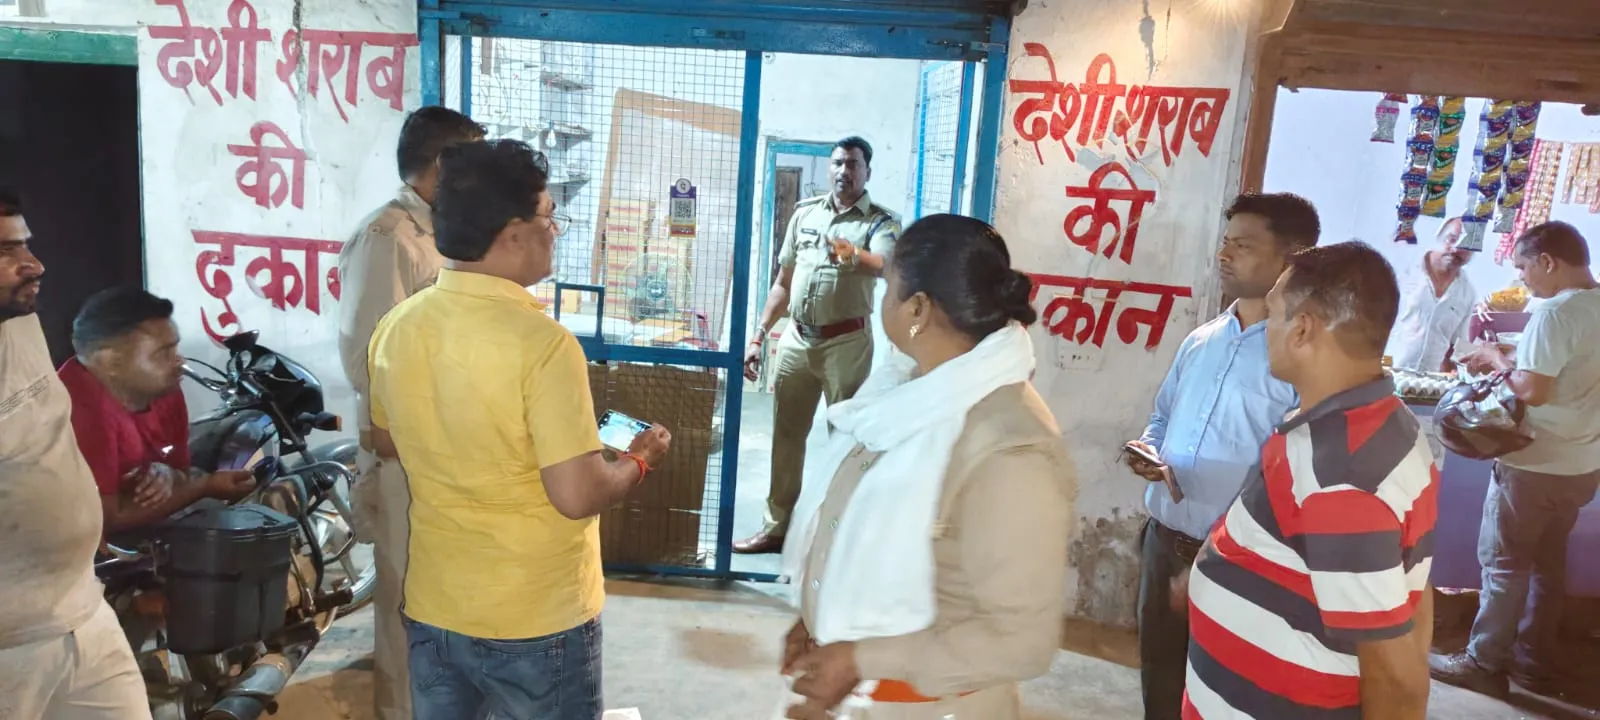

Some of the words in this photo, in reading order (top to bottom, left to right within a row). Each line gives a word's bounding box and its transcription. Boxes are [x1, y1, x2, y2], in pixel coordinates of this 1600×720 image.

[148, 0, 272, 107] देशी
[276, 28, 420, 124] शराब
[1009, 42, 1127, 165] देशी
[1113, 84, 1231, 167] शराब
[227, 120, 312, 210] की
[1063, 161, 1156, 265] की
[1028, 273, 1193, 352] कान
